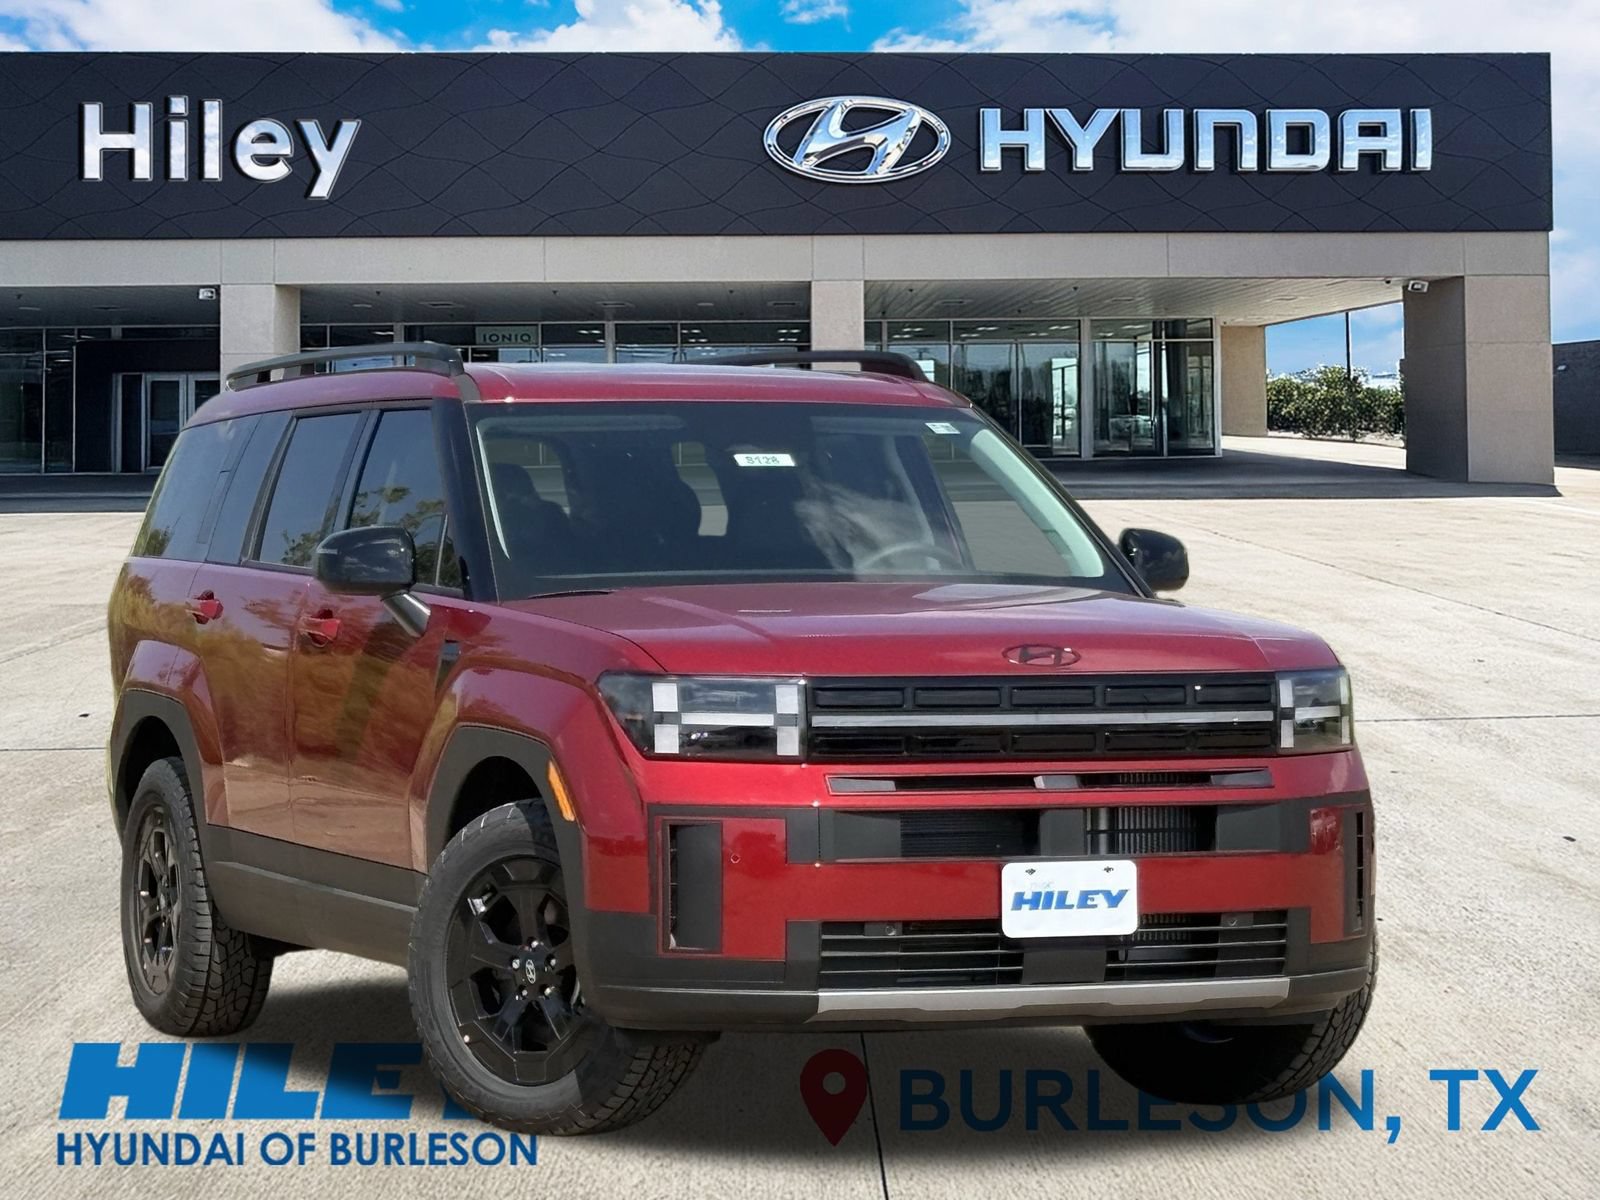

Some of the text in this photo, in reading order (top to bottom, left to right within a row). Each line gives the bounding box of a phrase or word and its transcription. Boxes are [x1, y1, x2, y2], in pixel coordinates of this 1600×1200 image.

[80, 95, 362, 199] Hiley
[979, 107, 1434, 172] HYUNDAI
[483, 333, 532, 343] IONIQ
[1010, 889, 1130, 911] HILEY
